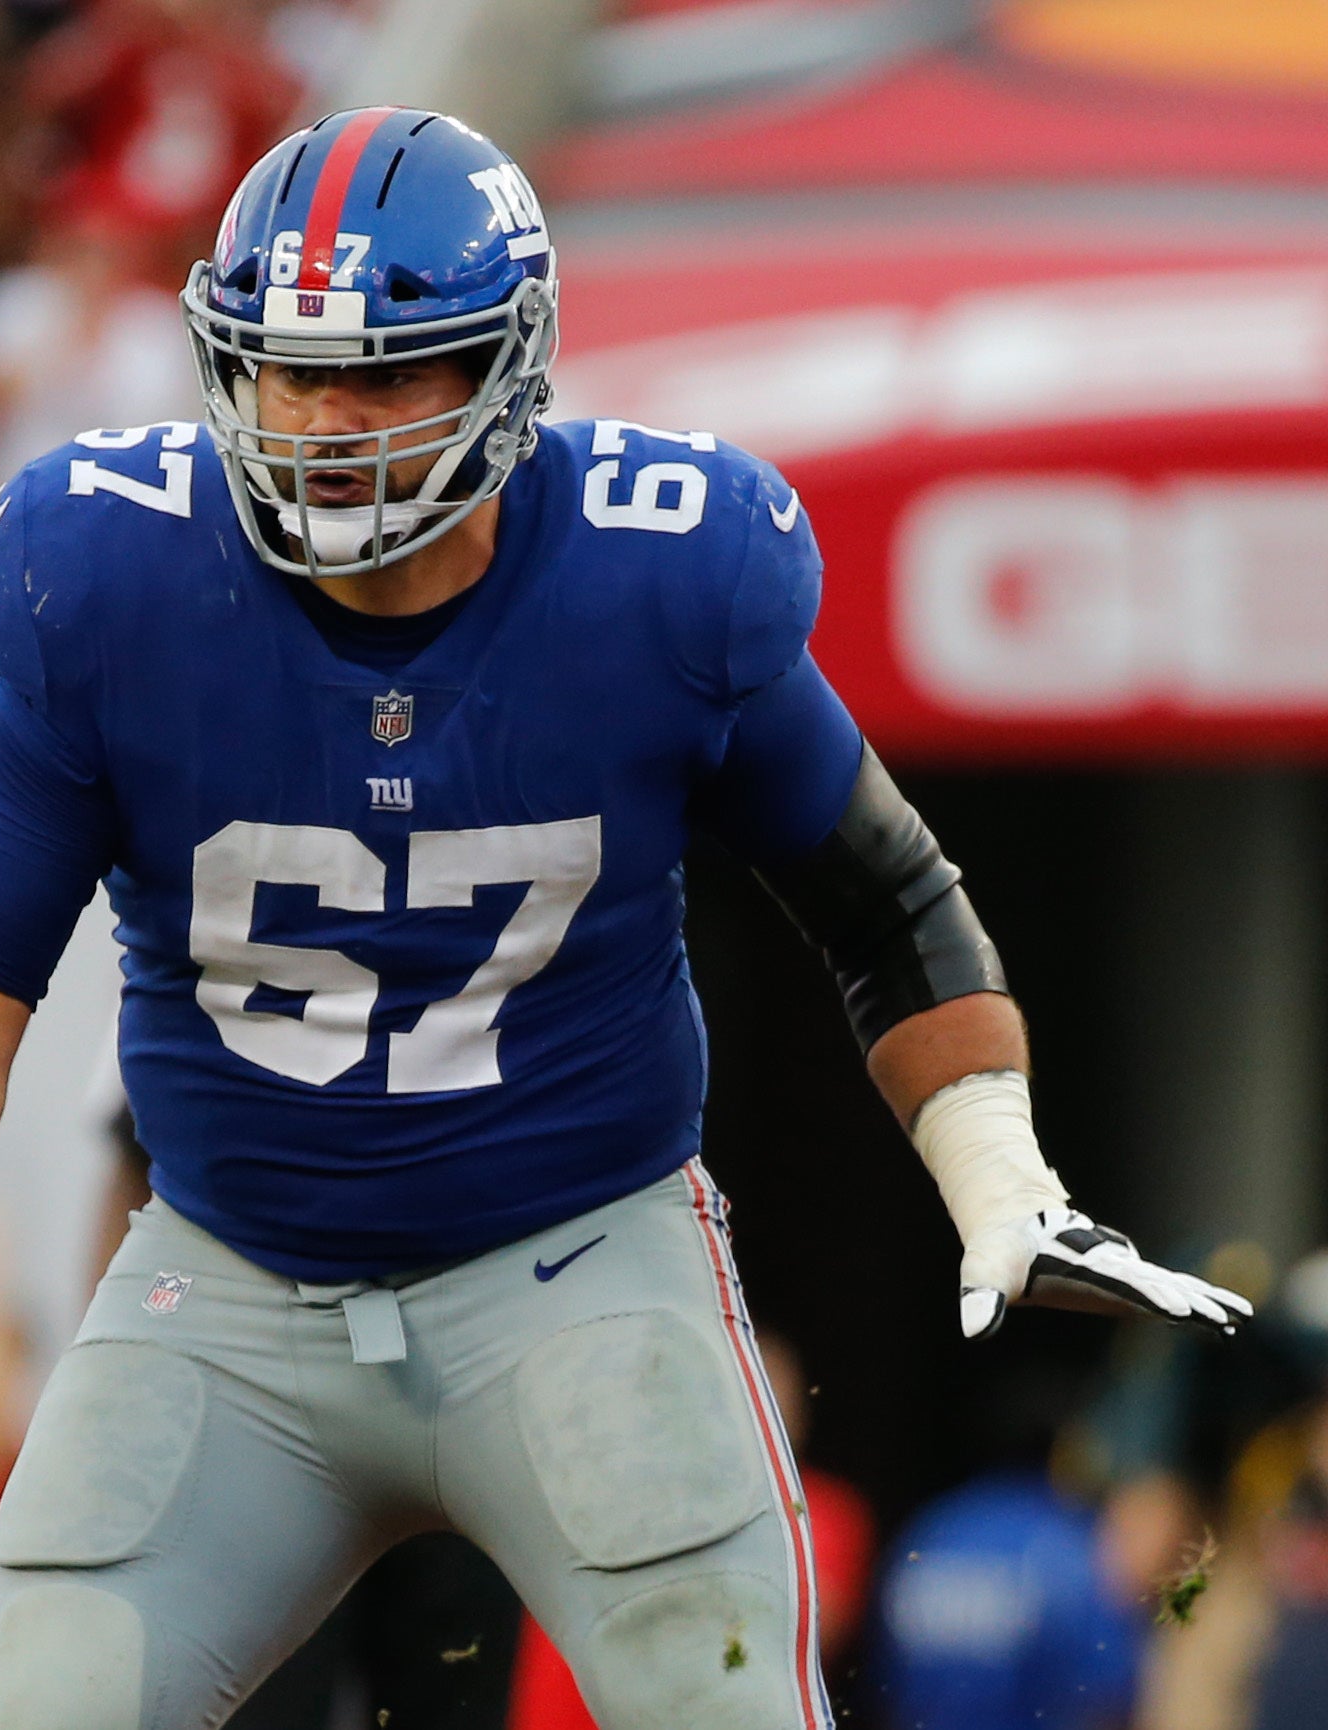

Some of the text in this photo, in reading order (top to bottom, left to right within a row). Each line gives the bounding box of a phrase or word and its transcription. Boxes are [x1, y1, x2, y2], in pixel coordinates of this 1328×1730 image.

[269, 230, 372, 289] 67
[66, 420, 199, 519] 67
[581, 419, 717, 535] 67
[188, 814, 602, 1094] 67
